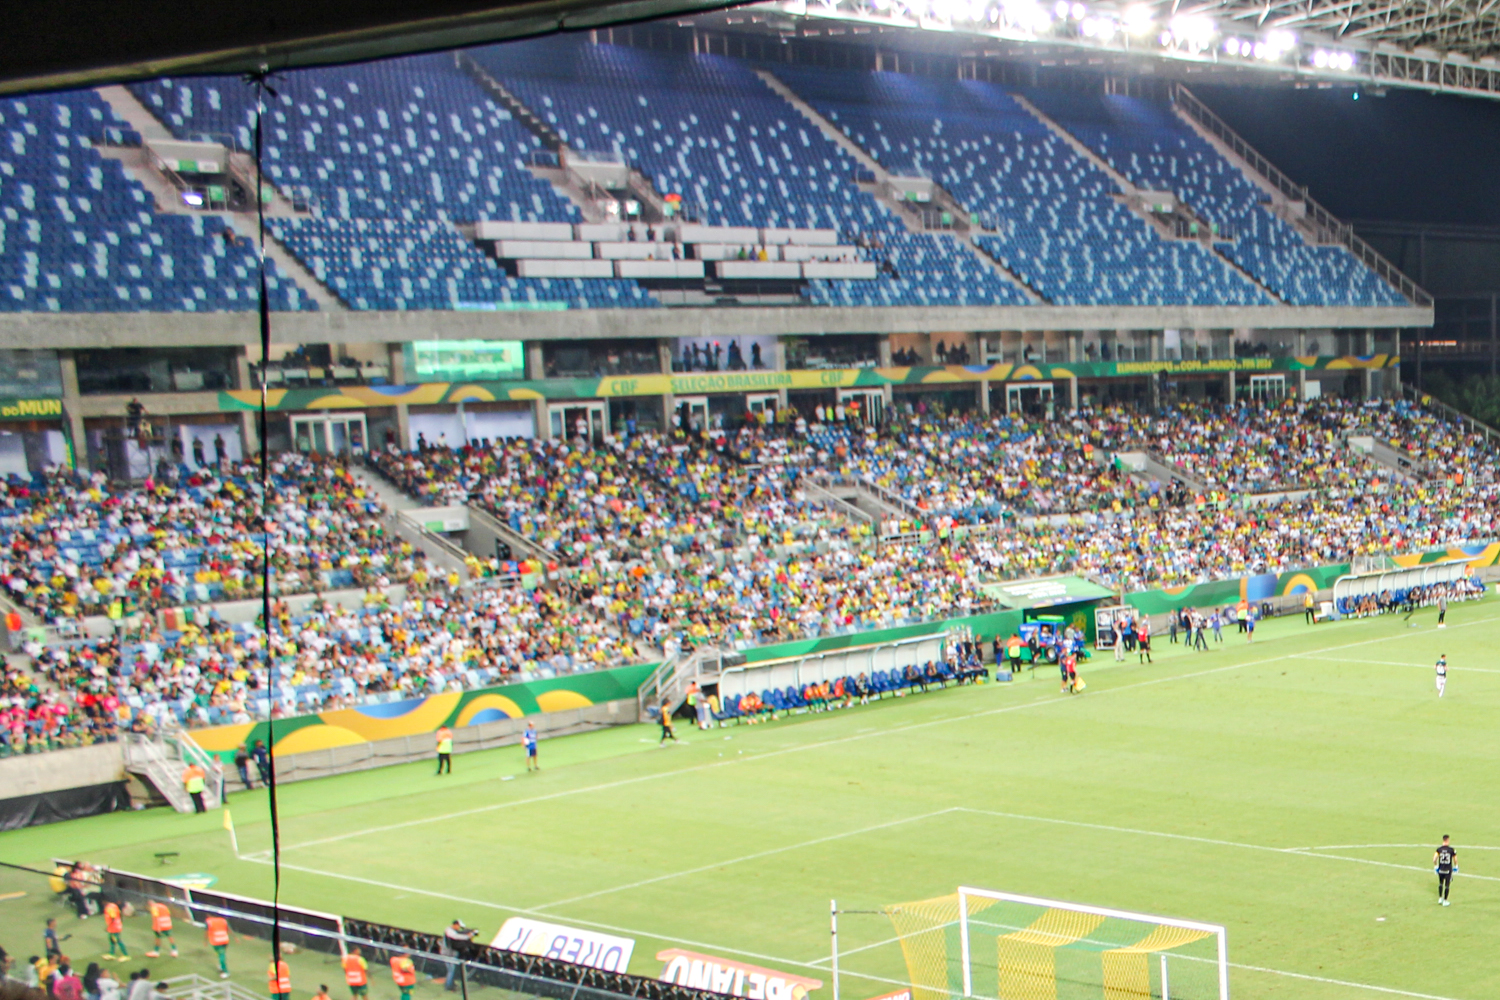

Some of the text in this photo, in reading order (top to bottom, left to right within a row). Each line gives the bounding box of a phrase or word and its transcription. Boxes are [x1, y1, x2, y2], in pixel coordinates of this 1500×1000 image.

[1180, 360, 1201, 371] COPA
[1208, 359, 1236, 370] MUNDO
[611, 380, 639, 395] CBF
[727, 372, 792, 388] BRASILEIRA
[821, 370, 844, 385] CBF
[1439, 853, 1451, 865] 23
